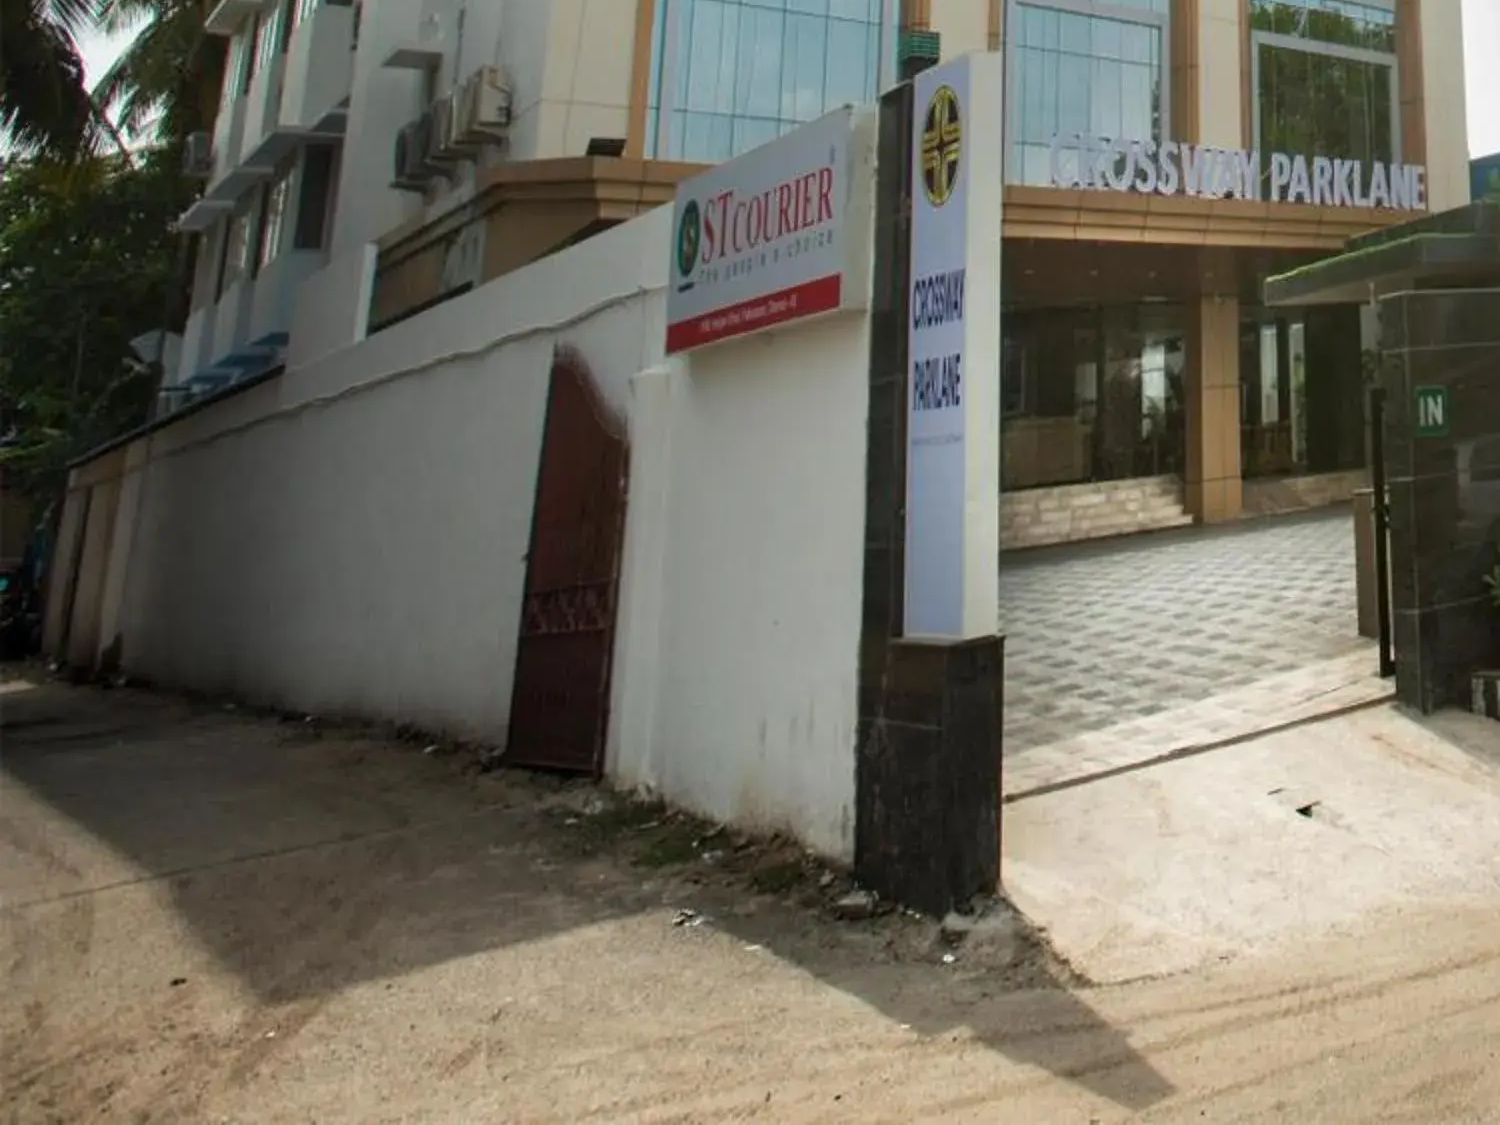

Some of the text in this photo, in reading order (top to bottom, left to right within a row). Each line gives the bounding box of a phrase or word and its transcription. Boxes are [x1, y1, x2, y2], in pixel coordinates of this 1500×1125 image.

[1051, 132, 1428, 210] CROSSWAY PARKLANE
[1419, 395, 1444, 426] IN
